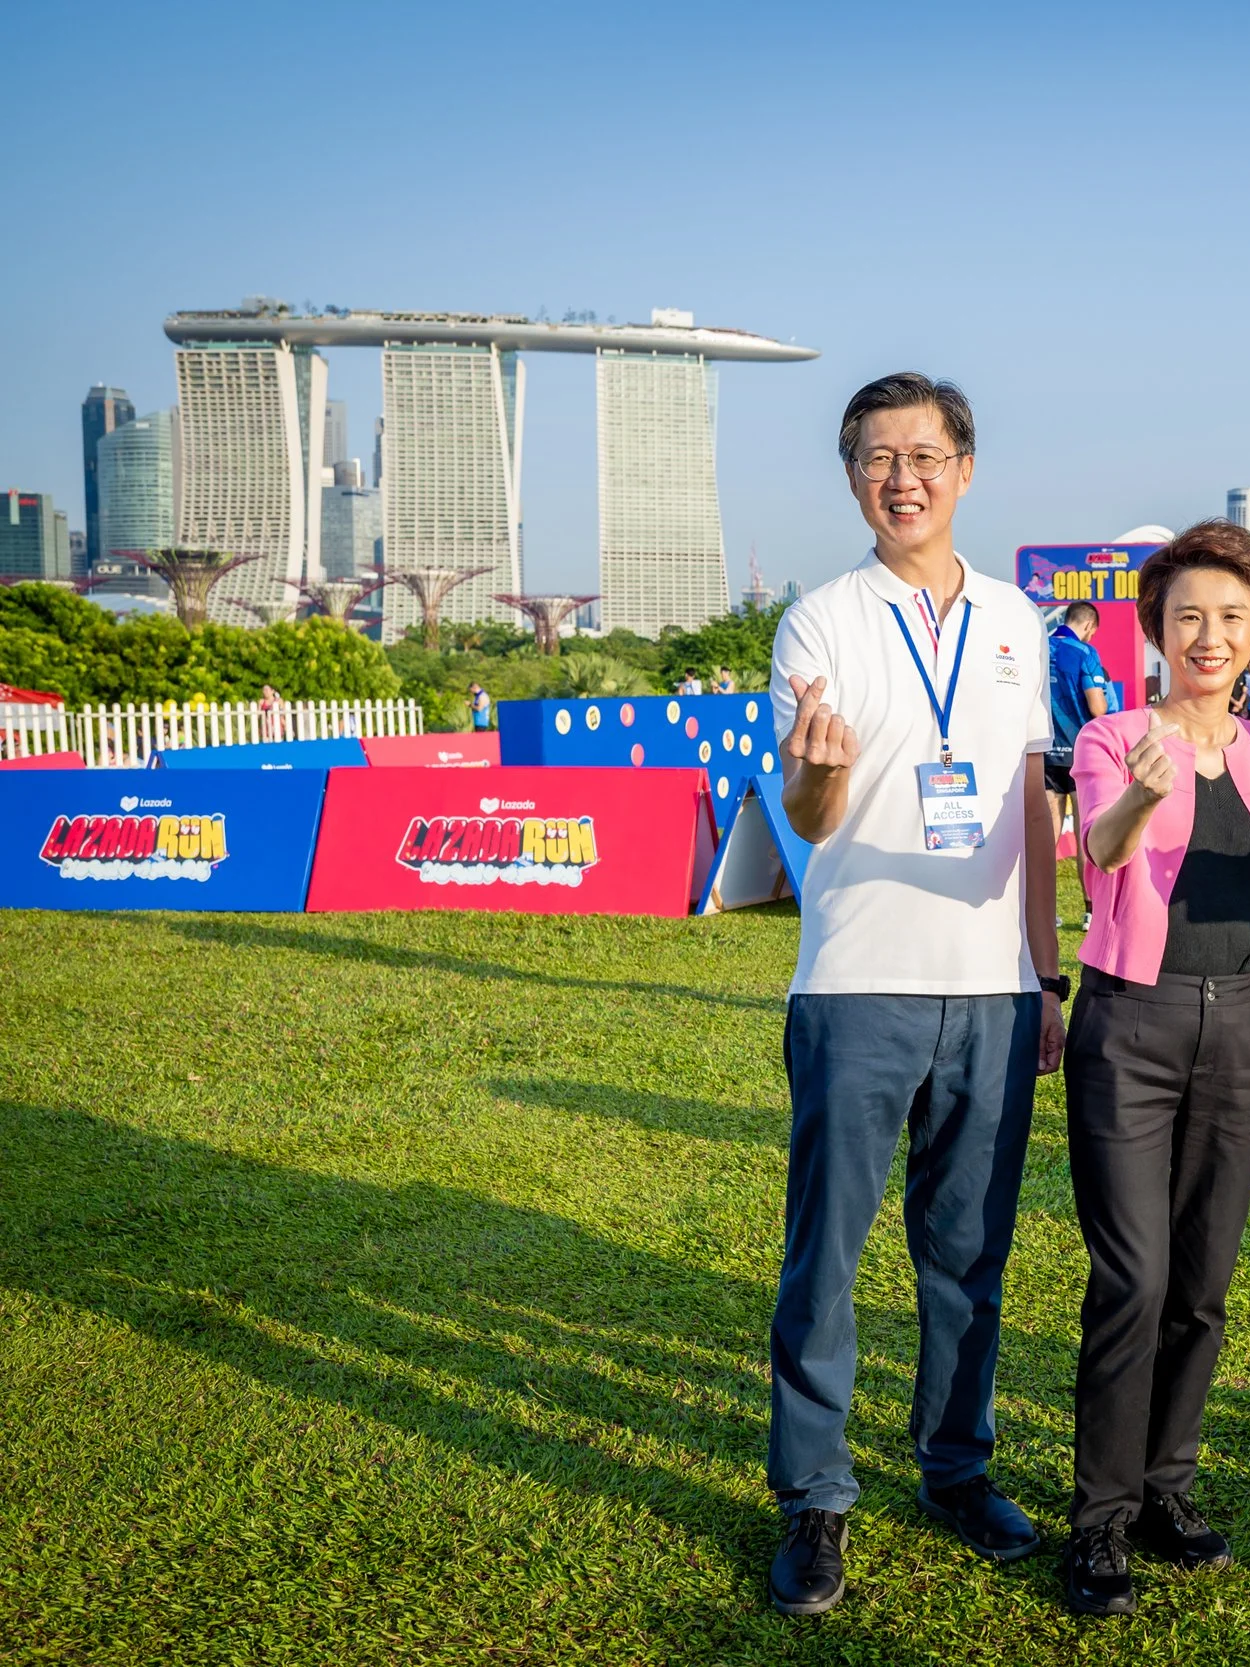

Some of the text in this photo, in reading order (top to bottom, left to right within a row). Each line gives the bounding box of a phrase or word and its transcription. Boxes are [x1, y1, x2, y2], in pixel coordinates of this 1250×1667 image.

[1054, 569, 1139, 600] CART DA
[140, 798, 172, 808] Lazada
[501, 799, 536, 810] Lazada
[943, 801, 963, 810] ALL
[933, 810, 975, 820] ACCESS
[41, 817, 158, 859] LAZADA
[401, 818, 521, 862] LAZADA
